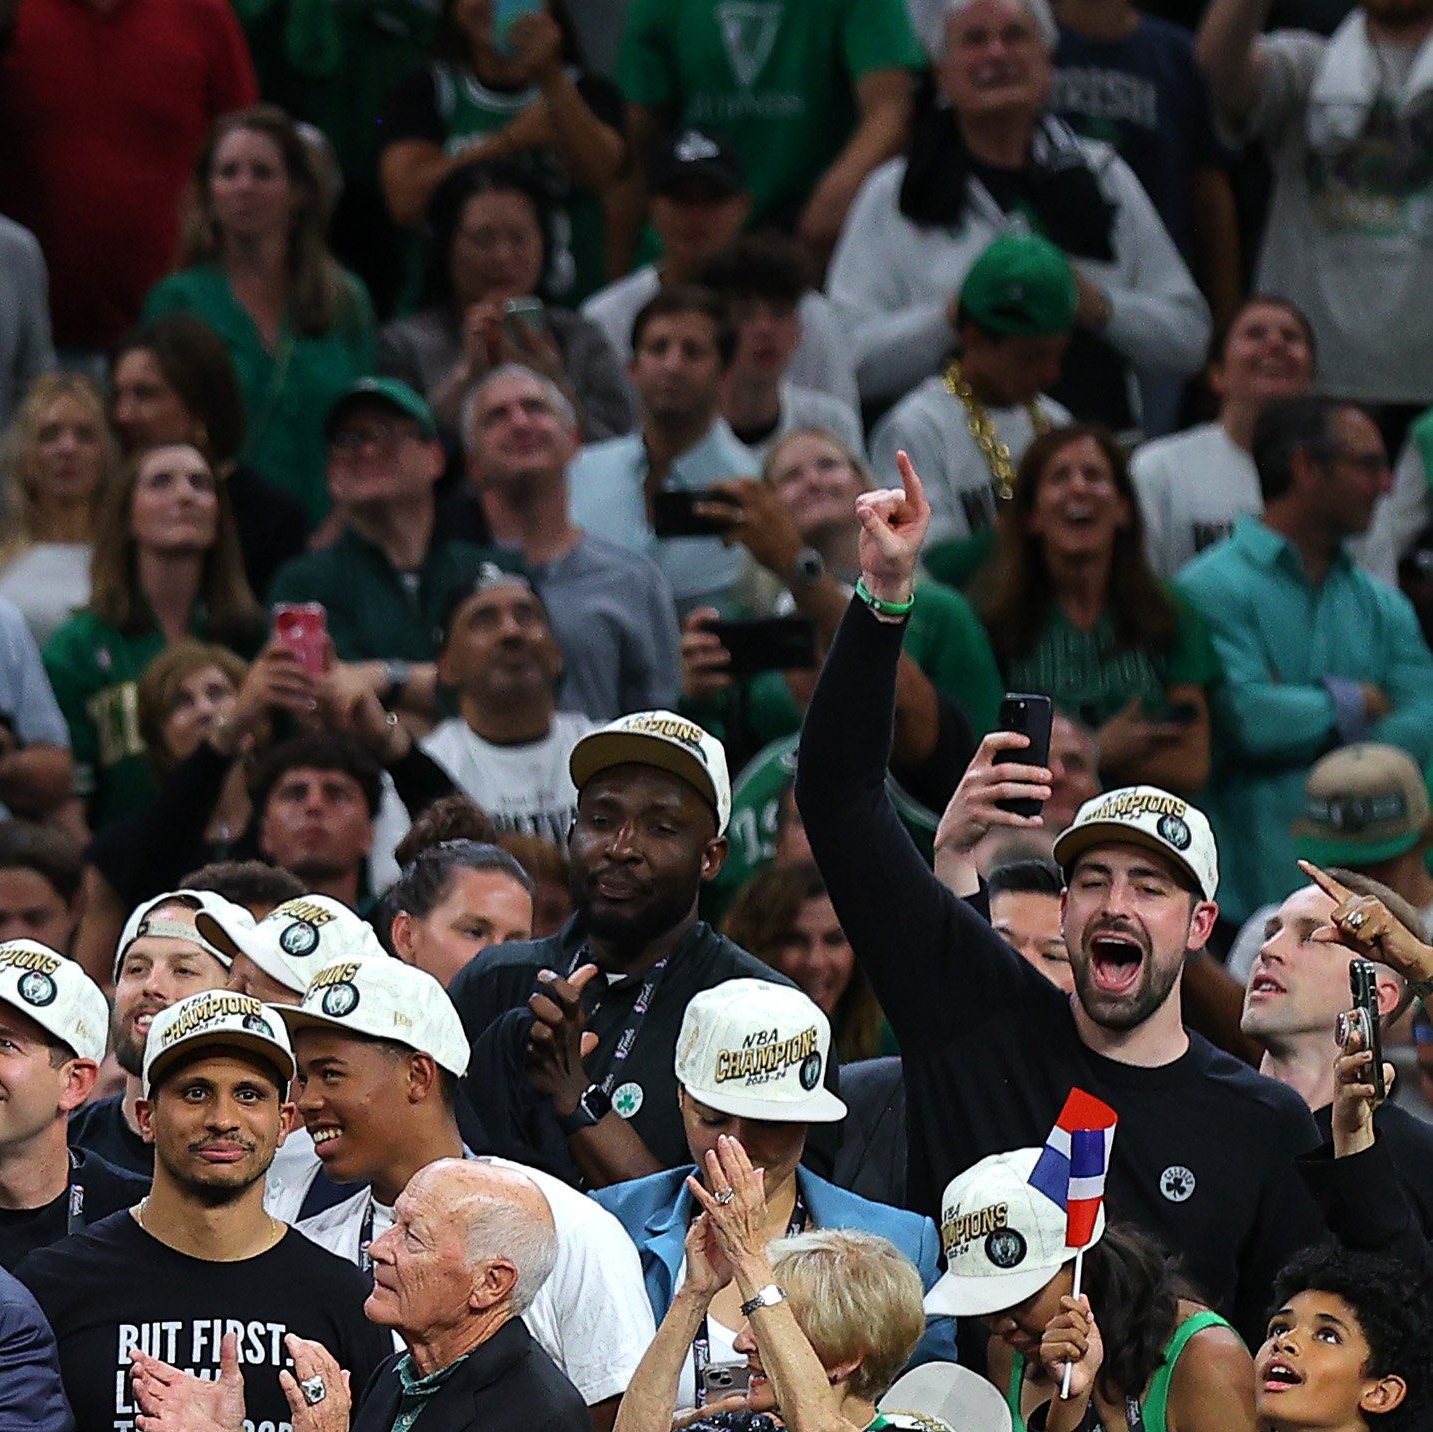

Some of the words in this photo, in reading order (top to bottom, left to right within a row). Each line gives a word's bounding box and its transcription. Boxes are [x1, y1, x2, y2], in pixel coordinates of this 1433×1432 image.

[715, 1026, 818, 1083] CHAMPIONS
[743, 1028, 779, 1049] NBA
[118, 1320, 182, 1367] BUT
